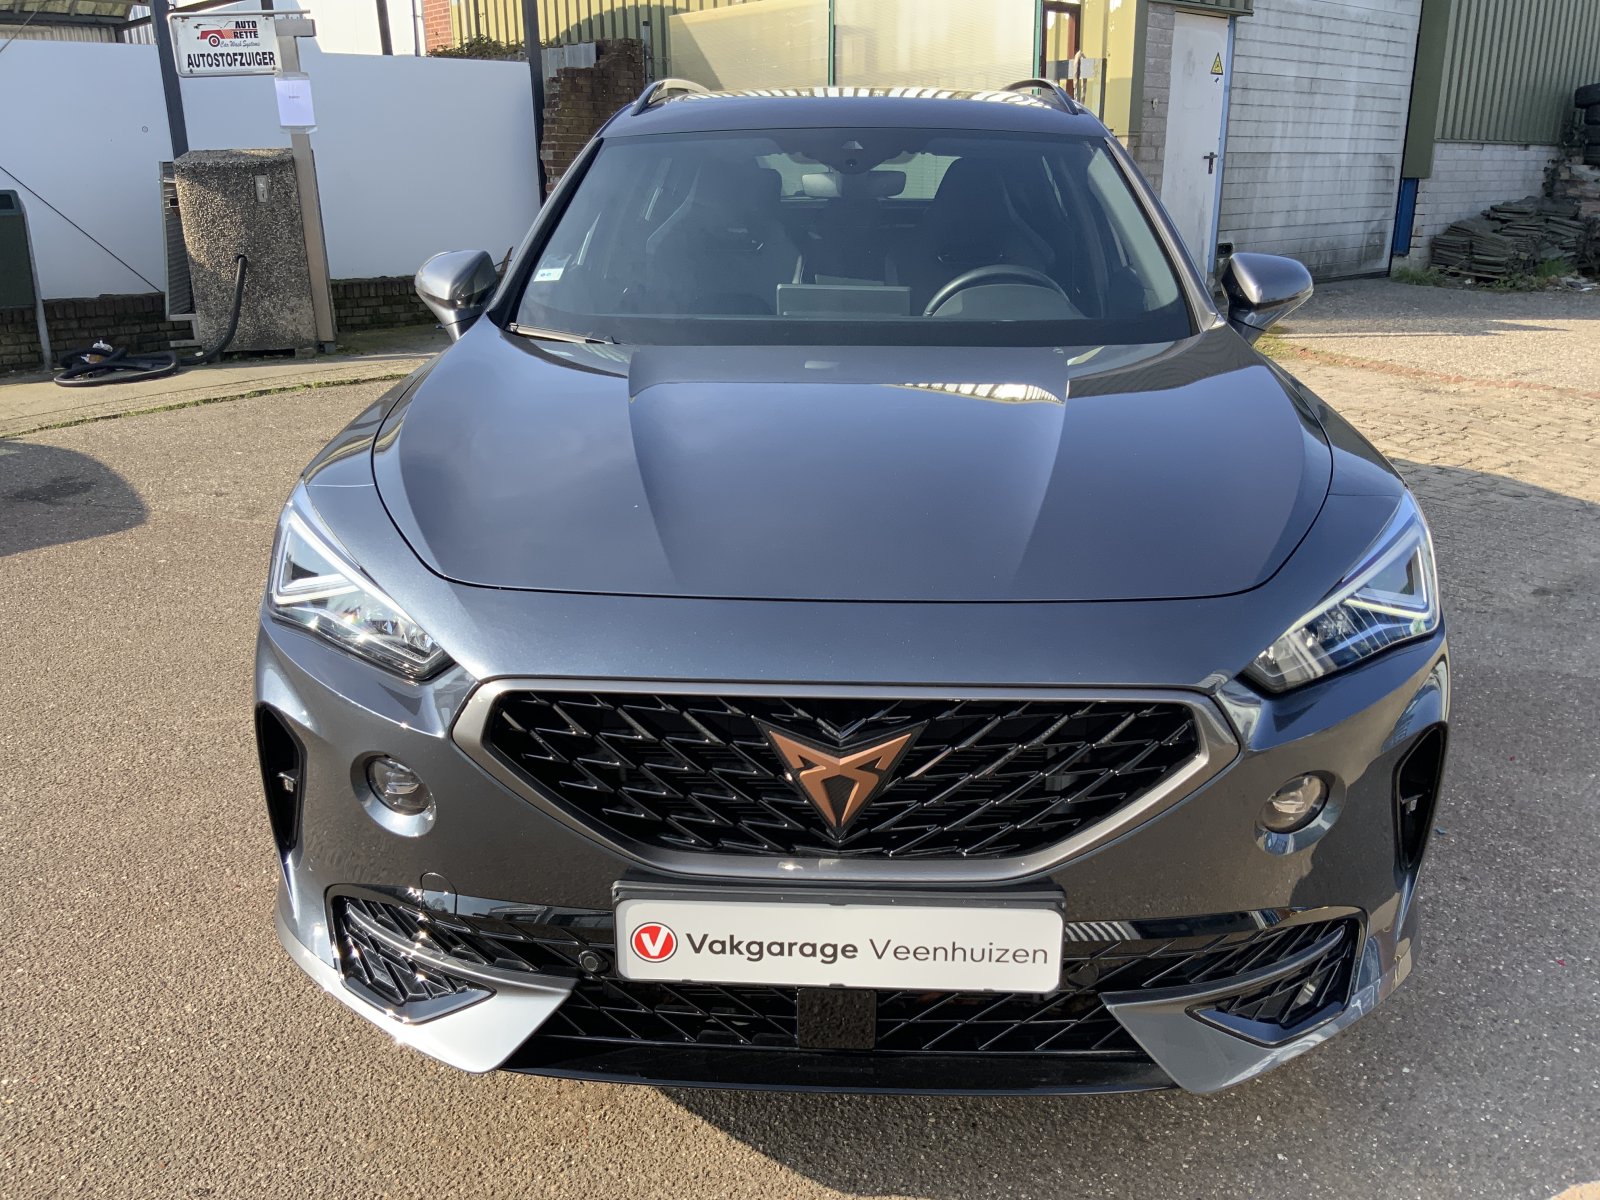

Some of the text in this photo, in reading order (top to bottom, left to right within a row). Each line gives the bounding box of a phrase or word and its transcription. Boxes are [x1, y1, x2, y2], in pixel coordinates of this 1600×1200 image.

[235, 20, 257, 29] AUTO
[233, 30, 259, 39] RETTE
[220, 40, 261, 48] Car Wash Systems
[187, 51, 276, 68] AUTOSTOFZUIGER
[686, 932, 1049, 966] Vakgarage Veenhuizen
